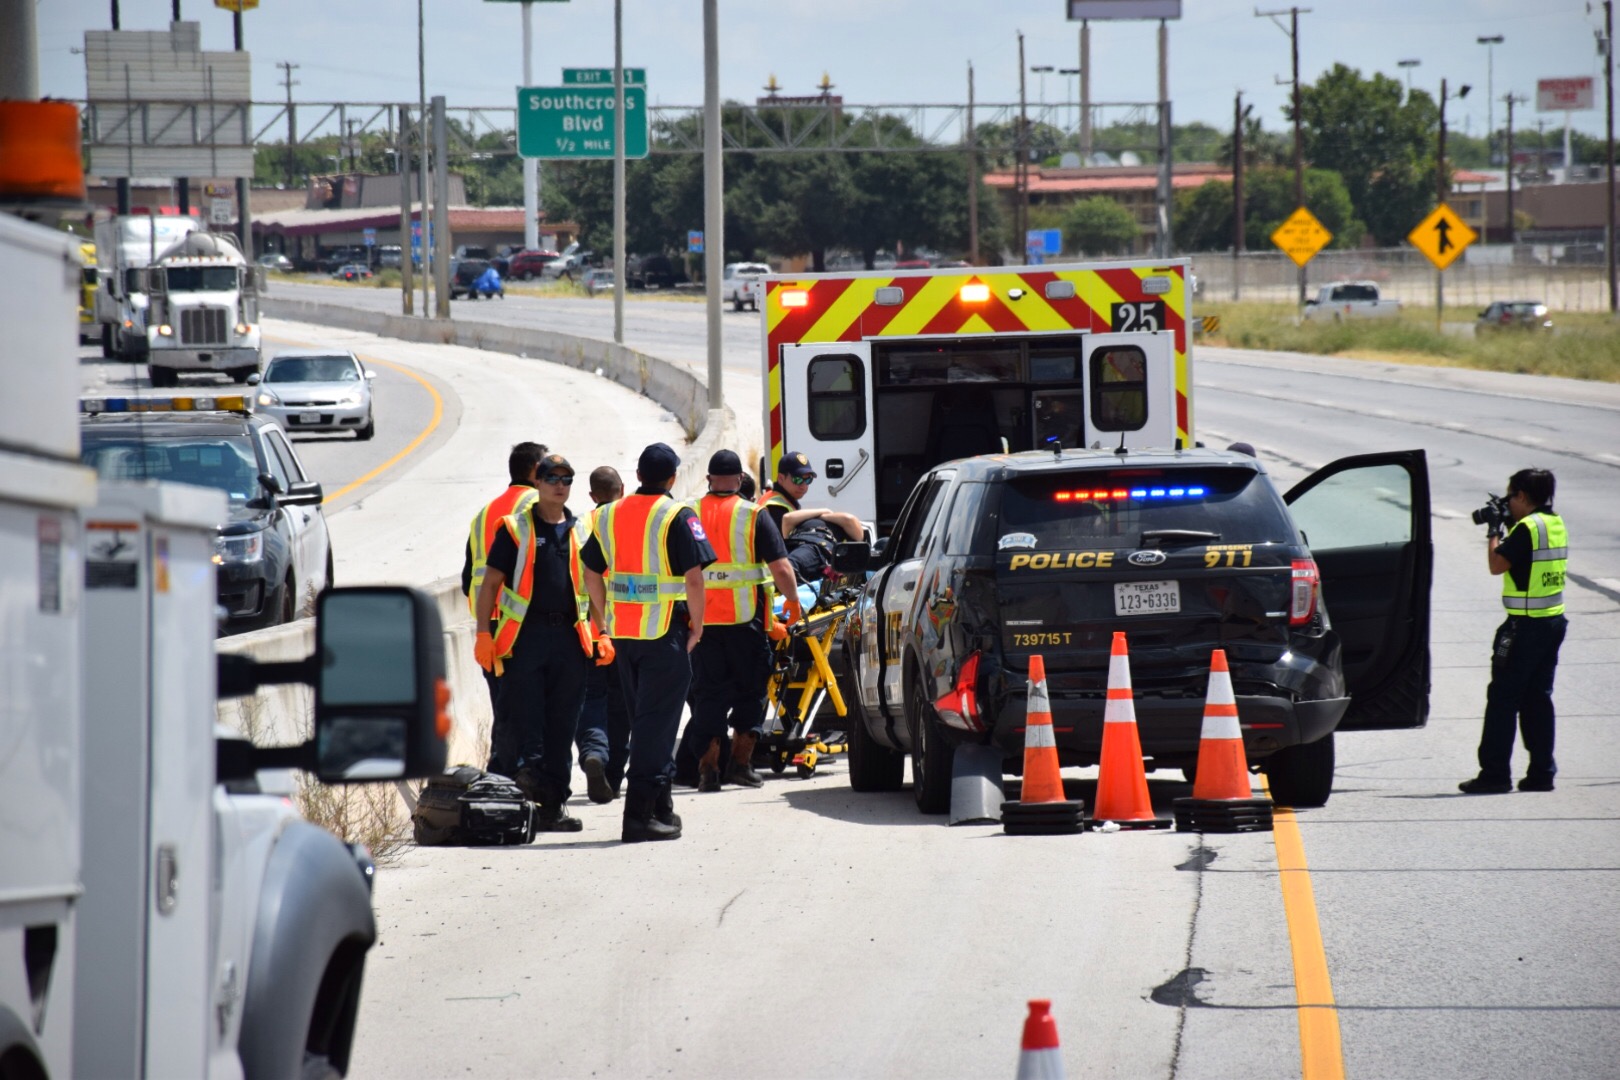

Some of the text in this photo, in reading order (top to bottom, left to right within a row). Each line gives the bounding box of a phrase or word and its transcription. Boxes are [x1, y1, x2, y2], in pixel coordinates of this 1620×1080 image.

[576, 70, 633, 83] EXIT 11
[529, 94, 635, 110] Southcros
[562, 115, 604, 132] Blvd
[583, 140, 611, 150] MILE
[1118, 303, 1158, 332] 25
[1009, 551, 1115, 571] POLICE
[1204, 550, 1253, 568] 911
[637, 584, 658, 594] CHIEF
[1133, 583, 1160, 591] TEXAS
[1014, 632, 1073, 646] 739715 T
